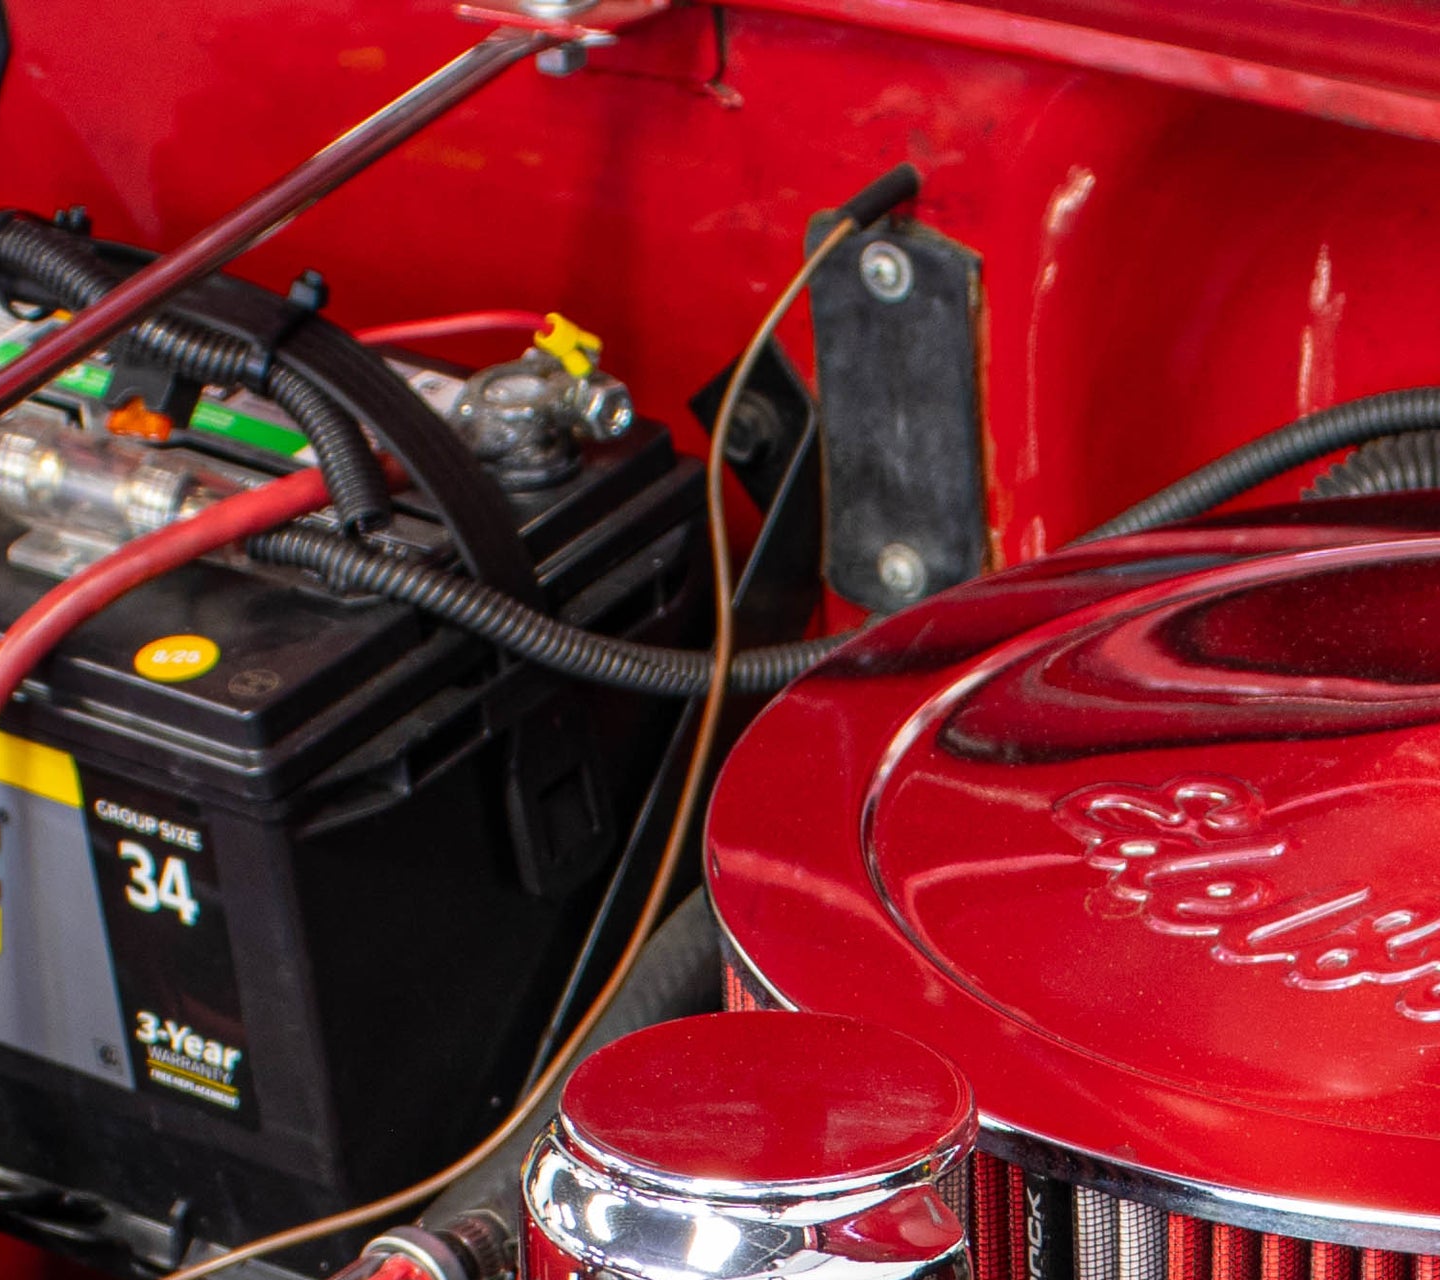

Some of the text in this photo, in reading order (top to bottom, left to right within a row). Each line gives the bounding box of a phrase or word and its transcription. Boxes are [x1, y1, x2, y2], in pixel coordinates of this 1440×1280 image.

[94, 799, 203, 851] GROUP SIZE
[117, 838, 200, 927] 34
[136, 1010, 242, 1073] 3-Year
